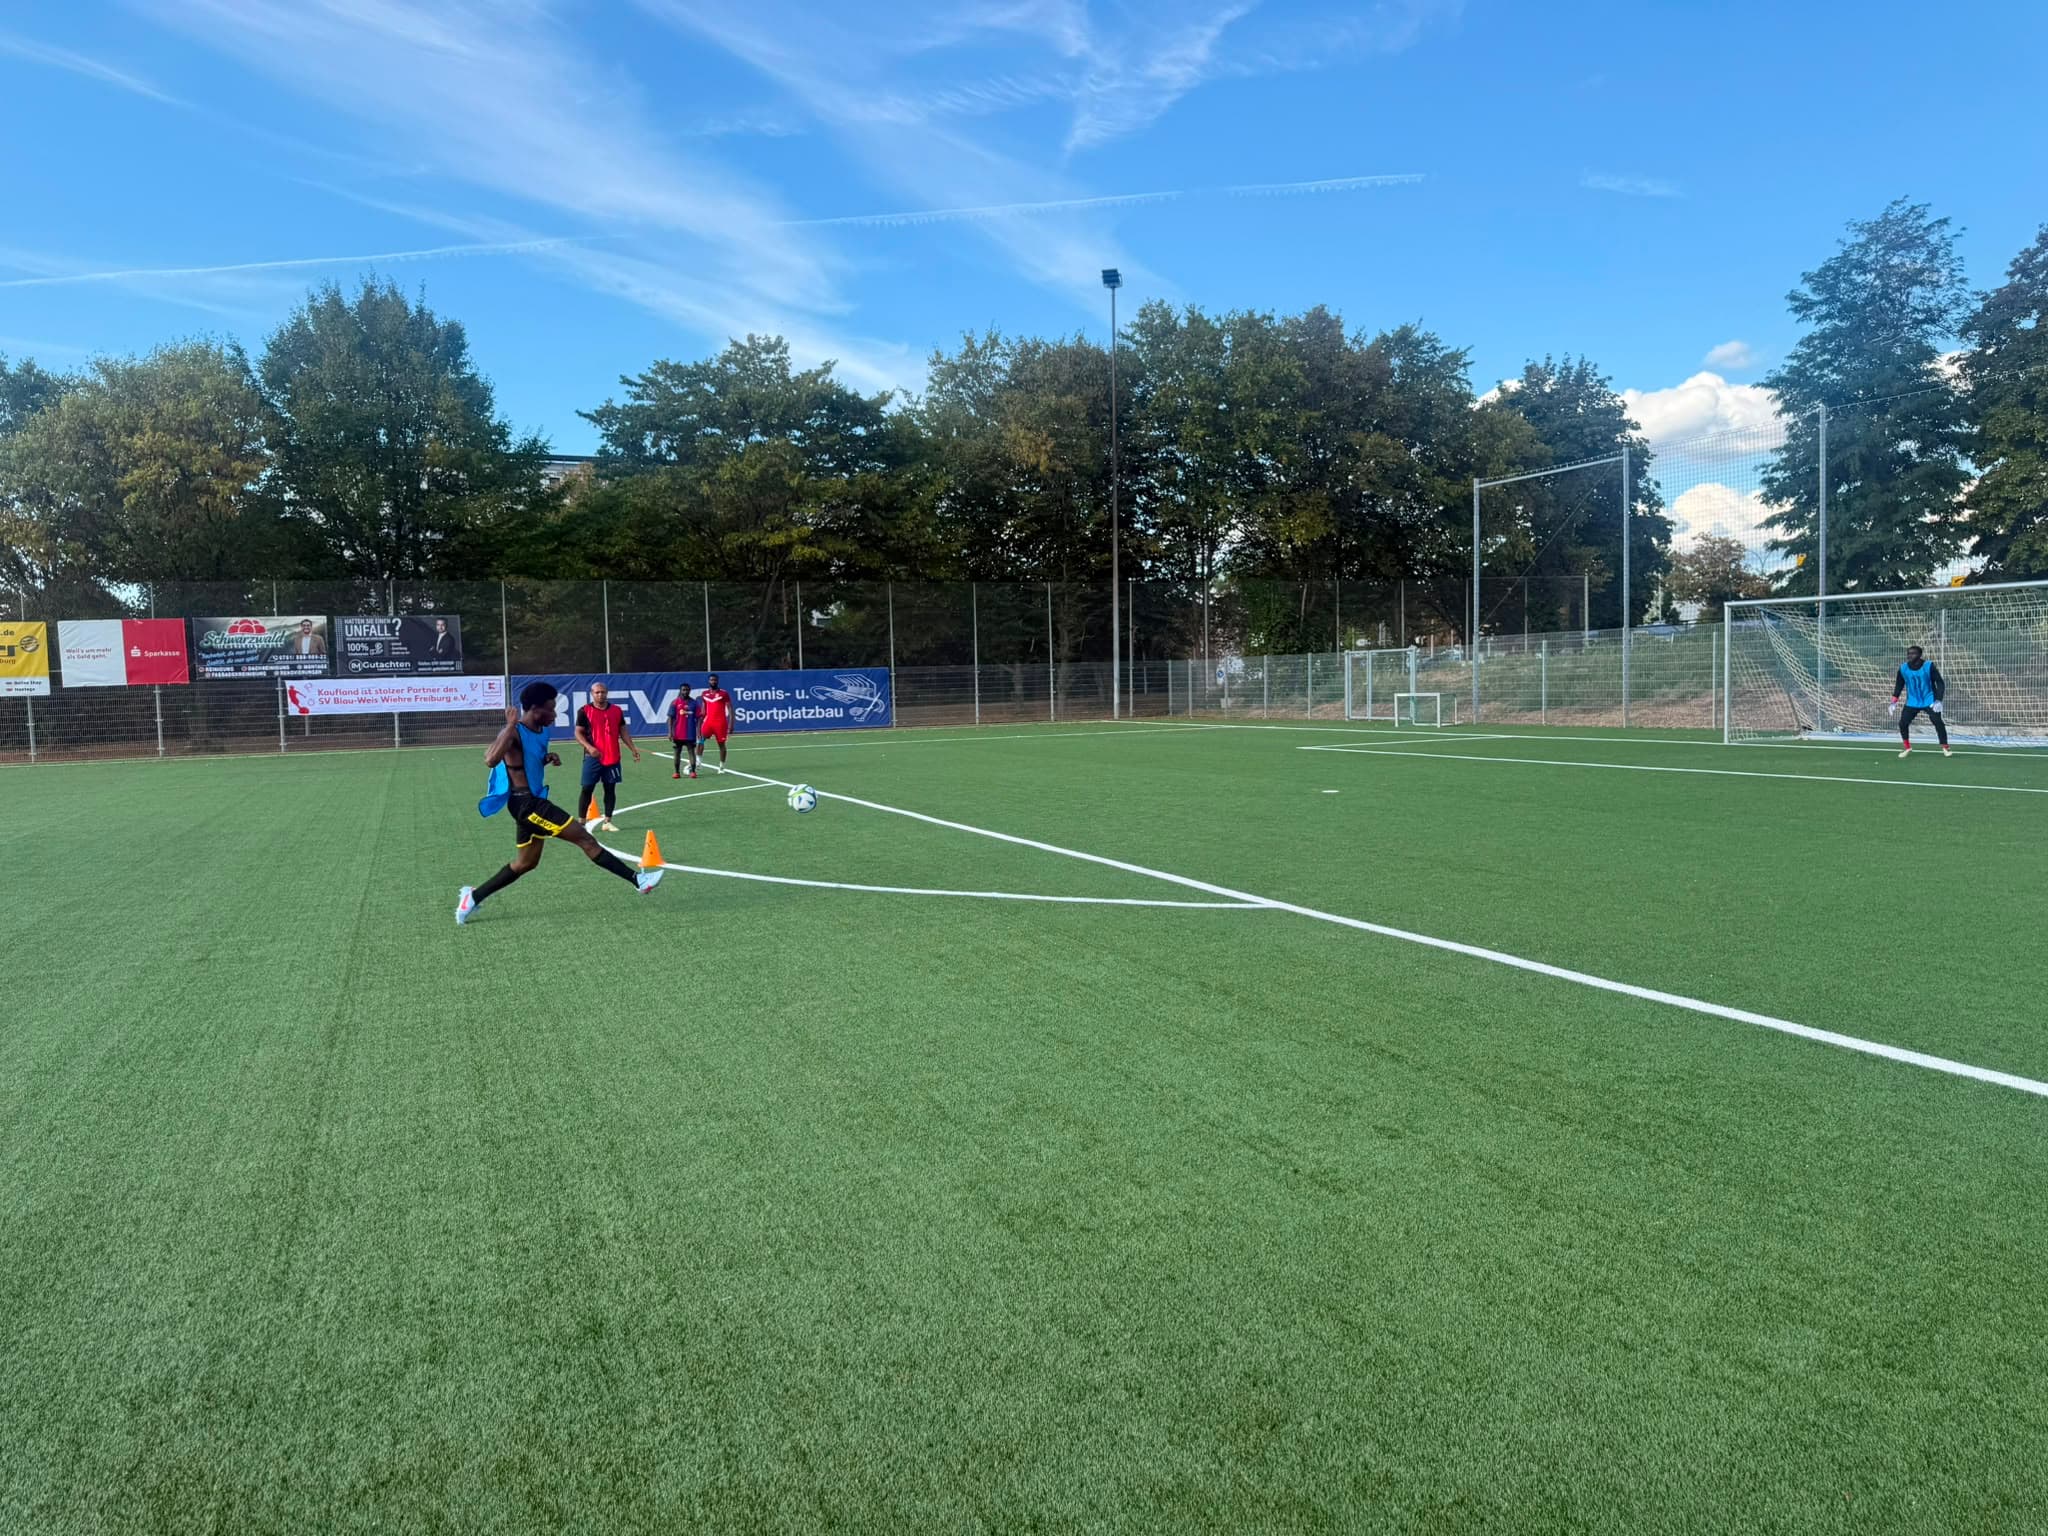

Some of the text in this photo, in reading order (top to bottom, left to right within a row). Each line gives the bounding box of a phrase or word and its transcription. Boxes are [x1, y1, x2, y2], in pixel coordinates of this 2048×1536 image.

[199, 630, 286, 648] Schwarzwald
[347, 642, 369, 651] 100%
[144, 650, 180, 659] Sparkasse
[362, 661, 411, 669] Gutachten
[317, 688, 359, 696] Kaufland
[374, 687, 405, 695] stolzer
[407, 686, 442, 694] Partner
[733, 687, 809, 701] Tennis- u.
[318, 697, 330, 705] SV
[381, 695, 412, 703] Wiehre
[414, 694, 451, 703] Freiburg
[734, 706, 844, 723] Sportplatzbau
